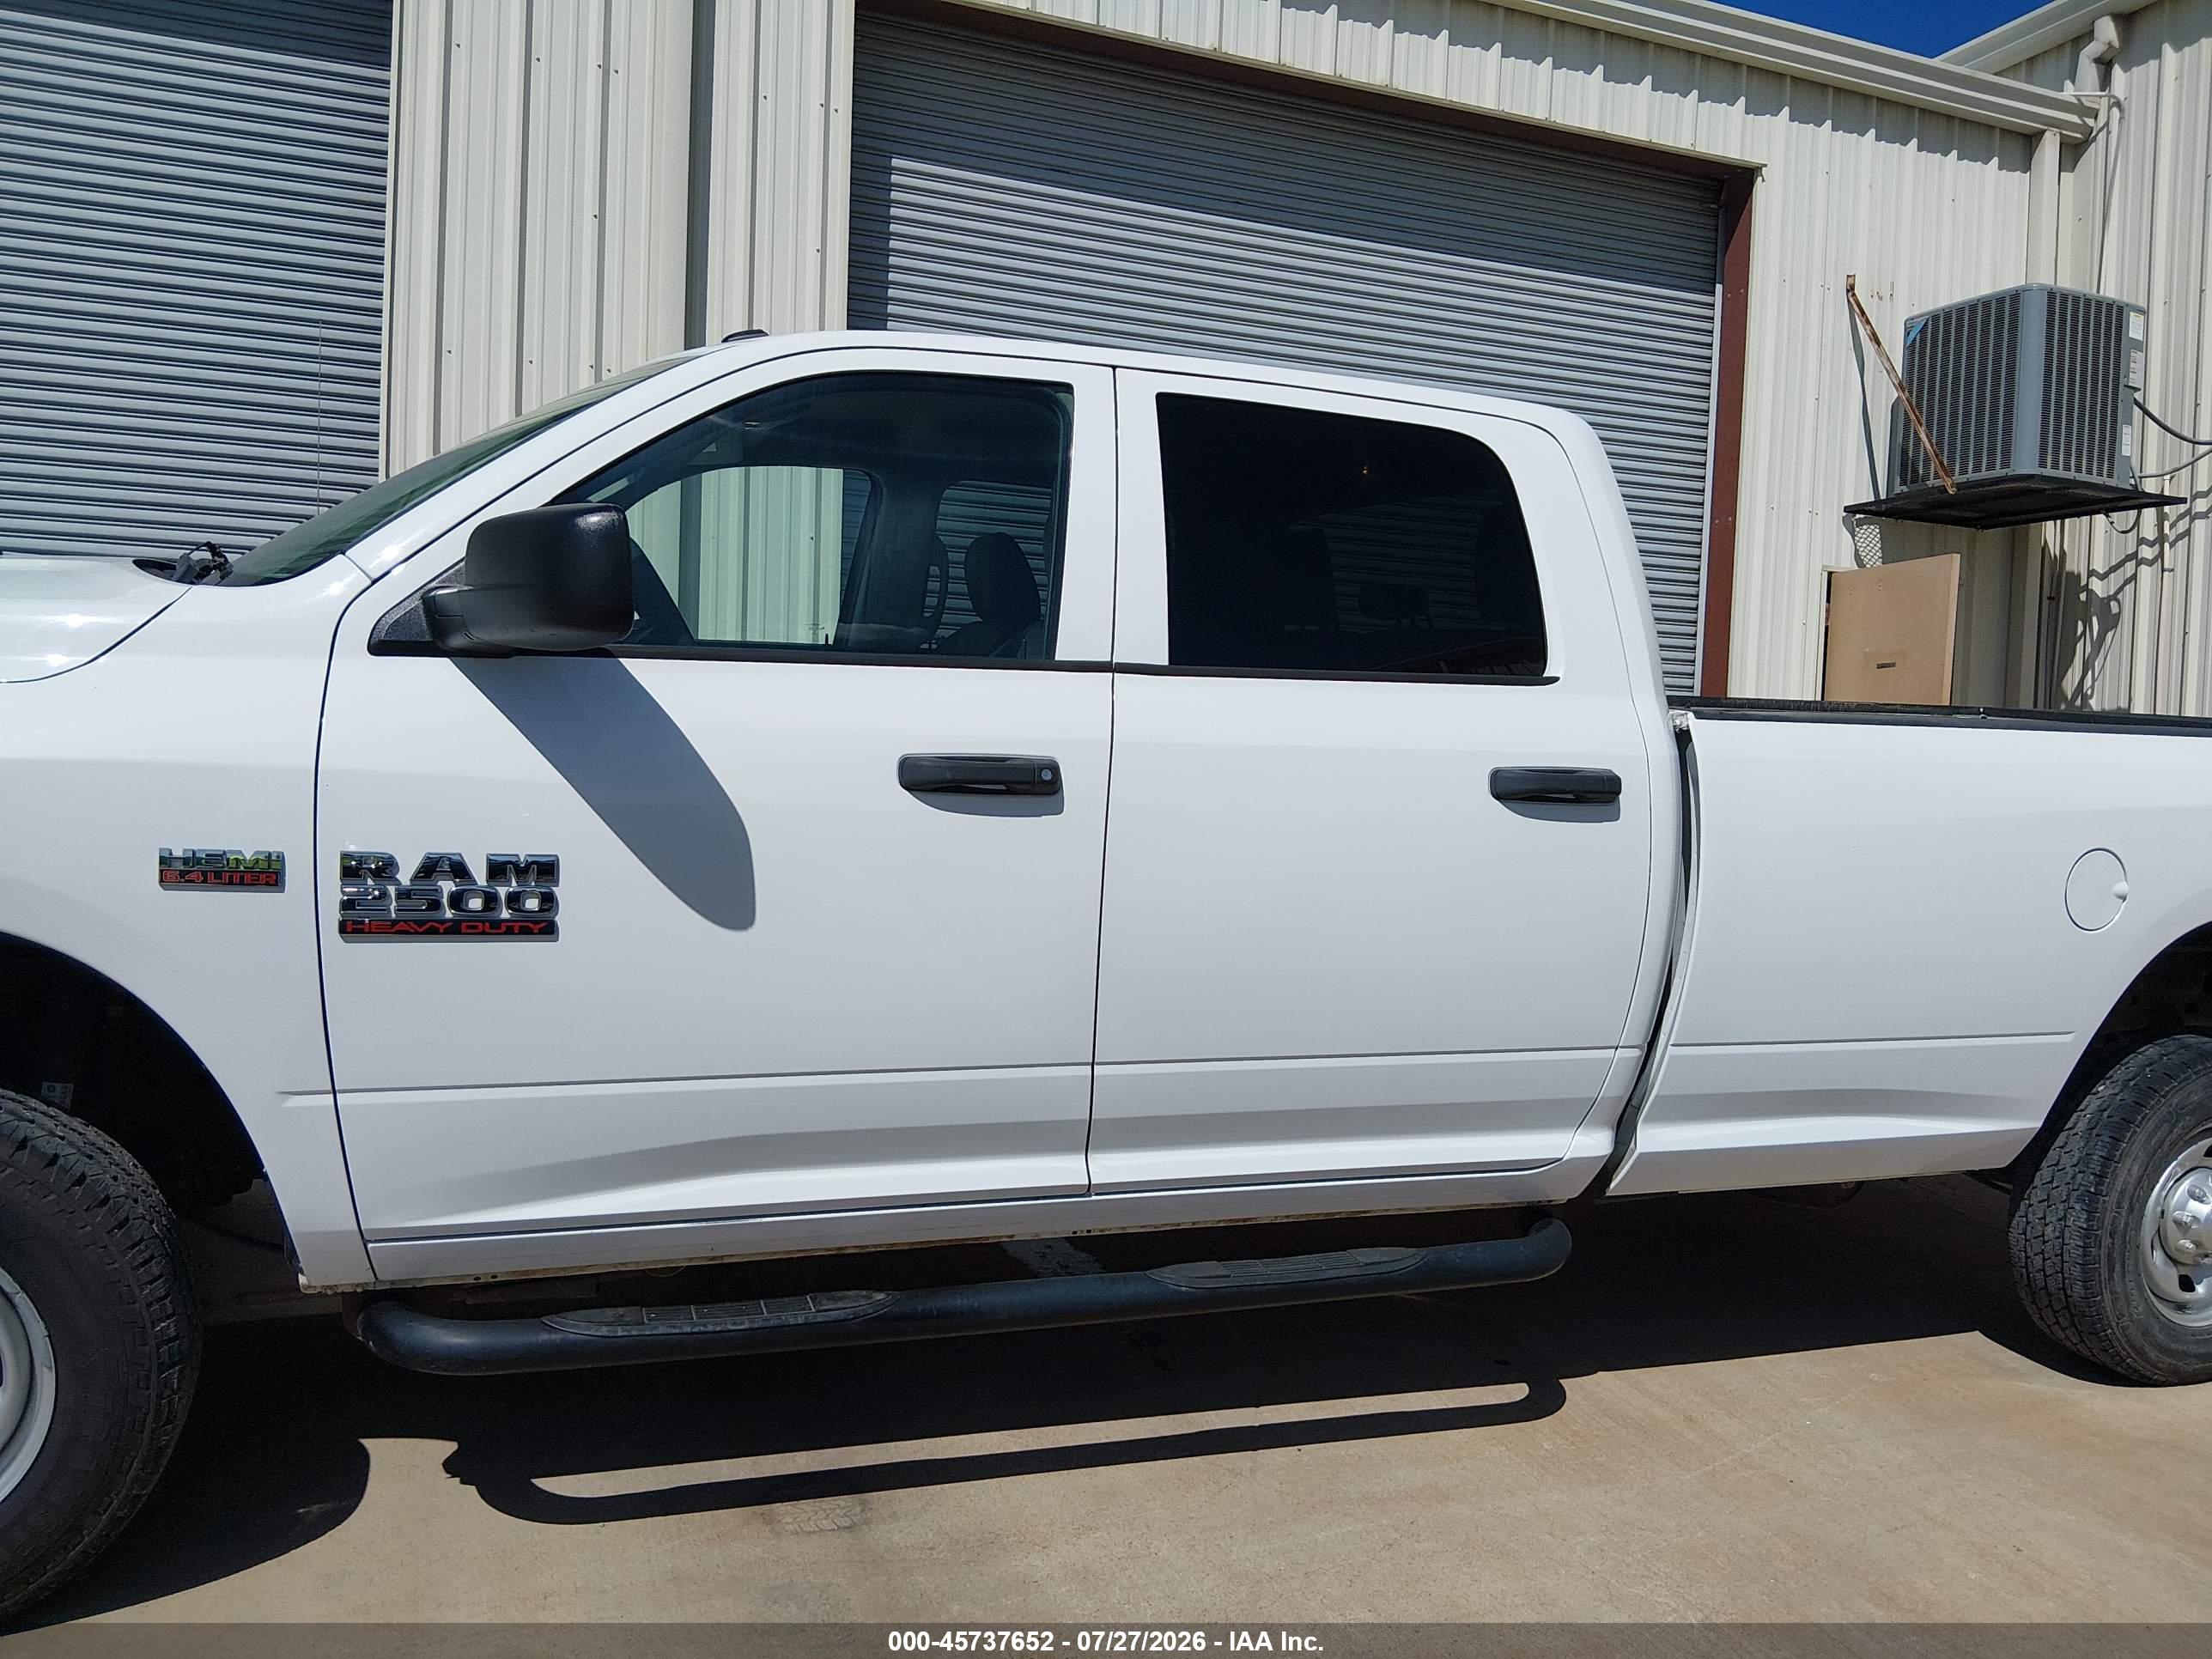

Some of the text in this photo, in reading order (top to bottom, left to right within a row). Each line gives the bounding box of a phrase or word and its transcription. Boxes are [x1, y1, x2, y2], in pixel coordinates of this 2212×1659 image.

[159, 848, 285, 870] HEMI
[340, 851, 559, 886] RAM
[162, 870, 276, 884] 6.4 LITER
[339, 885, 559, 918] 2500
[346, 921, 547, 933] HEAVY DUTY
